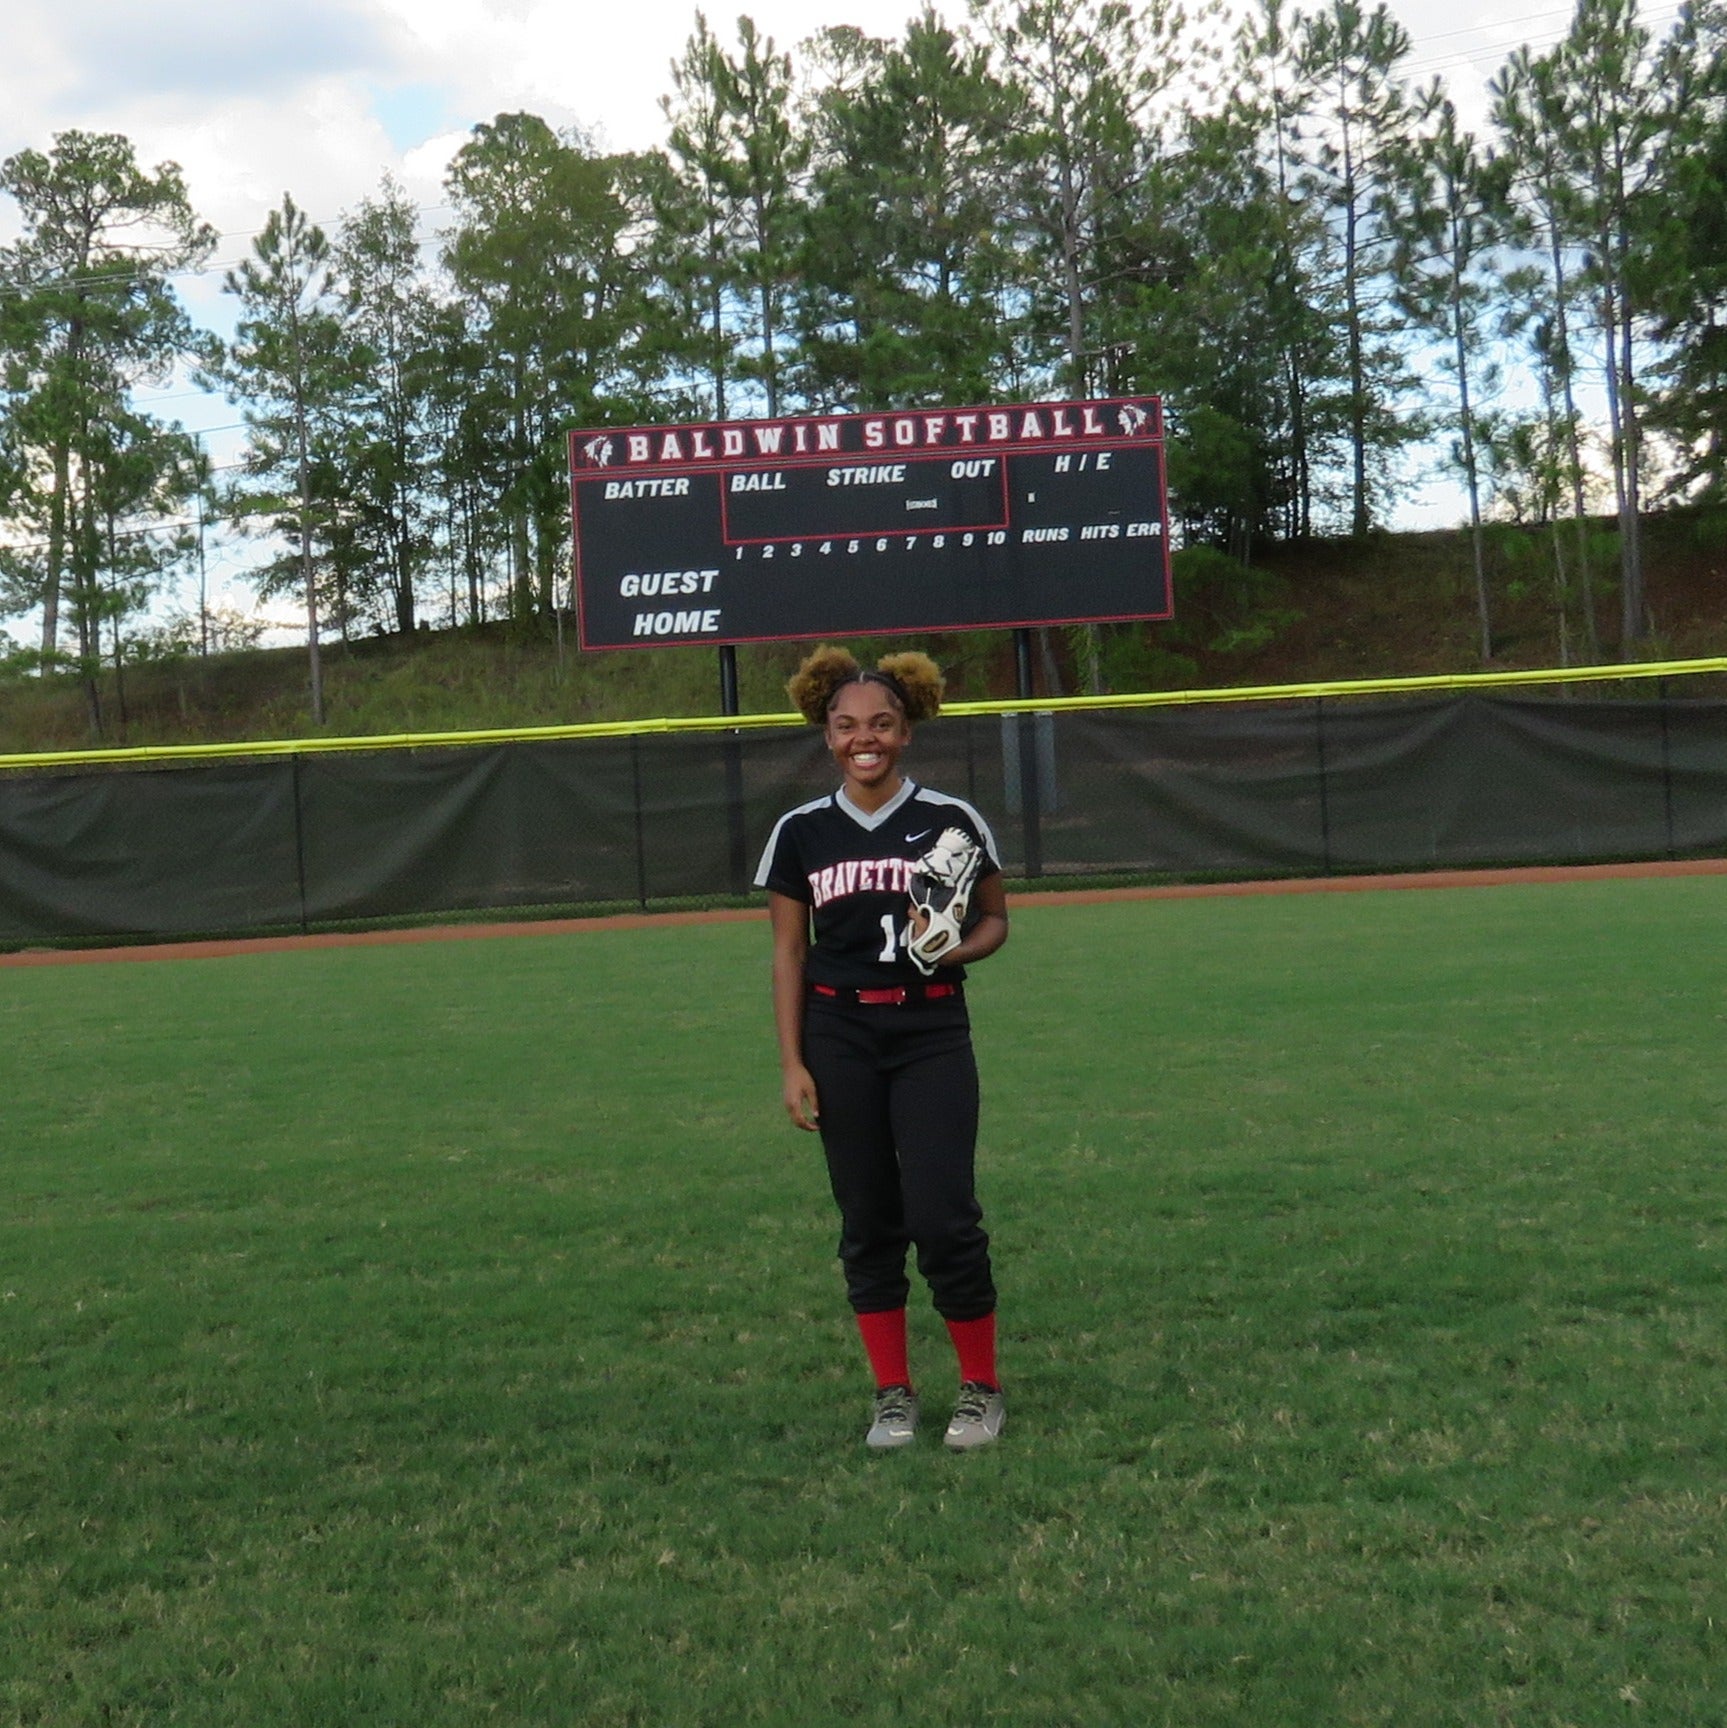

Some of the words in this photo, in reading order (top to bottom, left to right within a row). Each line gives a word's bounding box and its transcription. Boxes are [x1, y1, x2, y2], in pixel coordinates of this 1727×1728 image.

[628, 423, 840, 462] BALDWIN
[865, 407, 1103, 447] SOFTBALL
[950, 459, 996, 479] OUT
[1054, 454, 1071, 473] H
[1095, 452, 1112, 471] E
[730, 472, 787, 493] BALL
[826, 464, 907, 487] STRIKE
[604, 477, 690, 500] BATTER
[1022, 527, 1070, 543] RUNS
[1080, 524, 1120, 540] HITS
[1126, 522, 1162, 537] ERR
[736, 546, 743, 560] 1
[762, 544, 775, 559] 2
[790, 543, 802, 557] 3
[819, 541, 832, 555] 4
[847, 539, 859, 554] 5
[876, 538, 888, 552] 6
[906, 536, 917, 550] 7
[932, 534, 945, 549] 8
[962, 532, 974, 547] 9
[987, 530, 1006, 545] 10
[619, 569, 720, 598] GUEST
[633, 609, 722, 636] HOME
